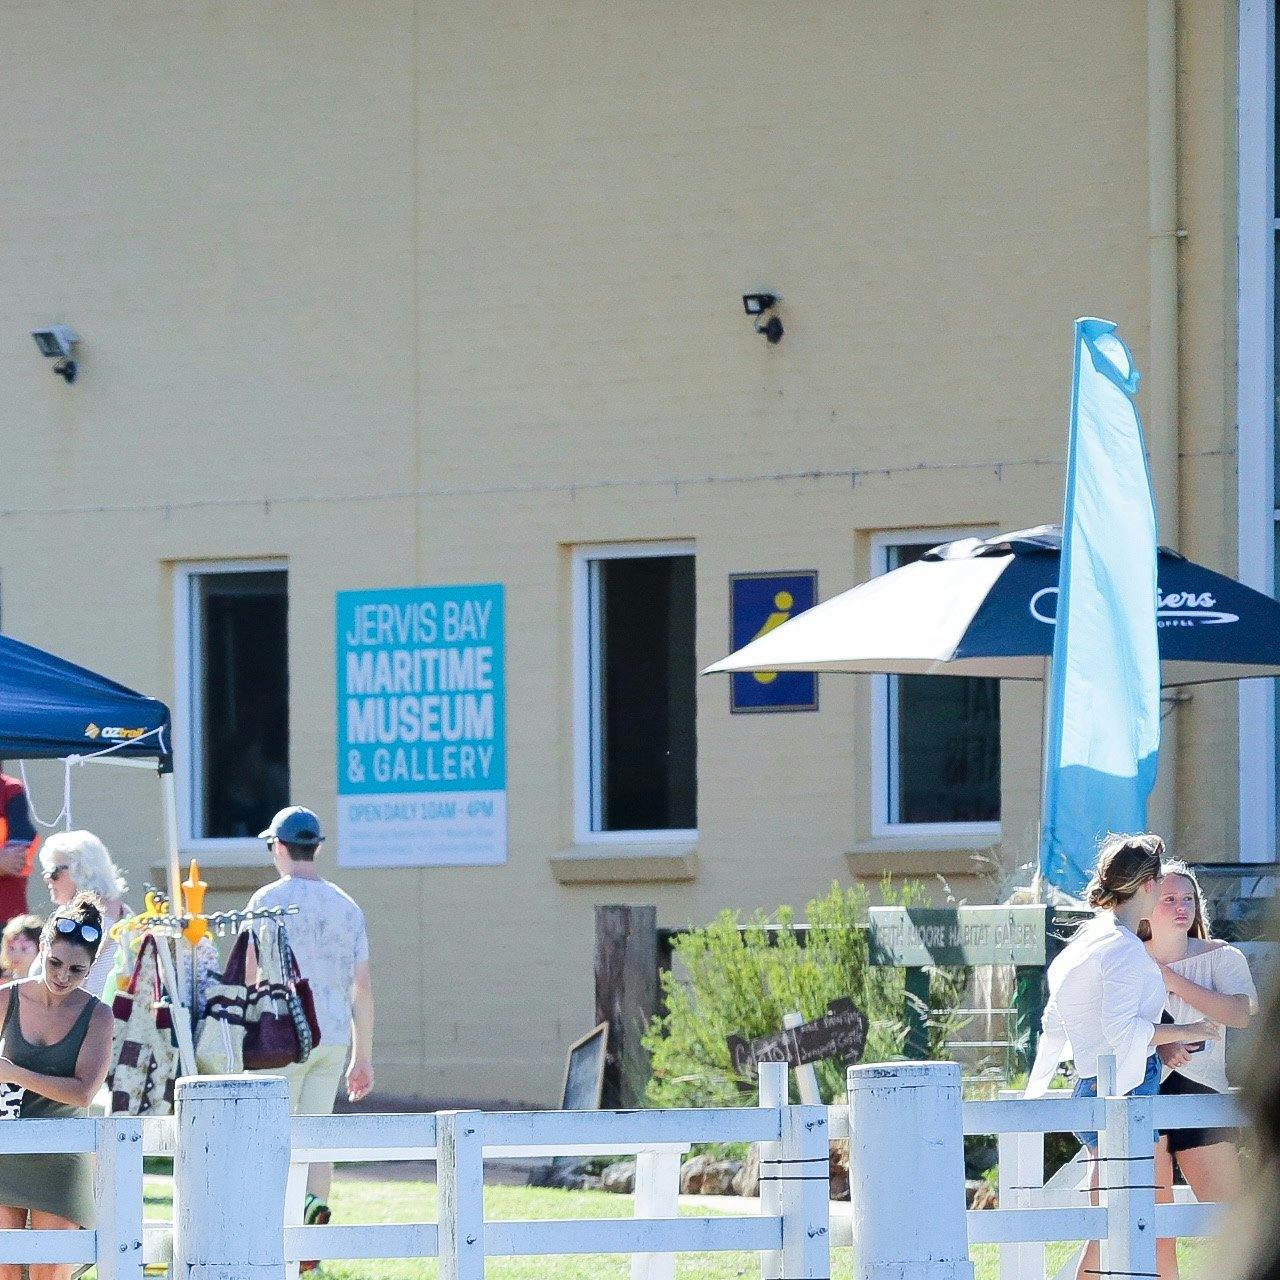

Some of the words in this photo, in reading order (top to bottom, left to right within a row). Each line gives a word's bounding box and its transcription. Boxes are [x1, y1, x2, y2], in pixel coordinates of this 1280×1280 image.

[346, 602, 438, 646] JERVIS
[442, 600, 493, 641] BAY
[346, 646, 493, 694] MARITIME
[346, 693, 495, 744] MUSEUM
[347, 749, 365, 783] &
[372, 745, 493, 782] GALLERY
